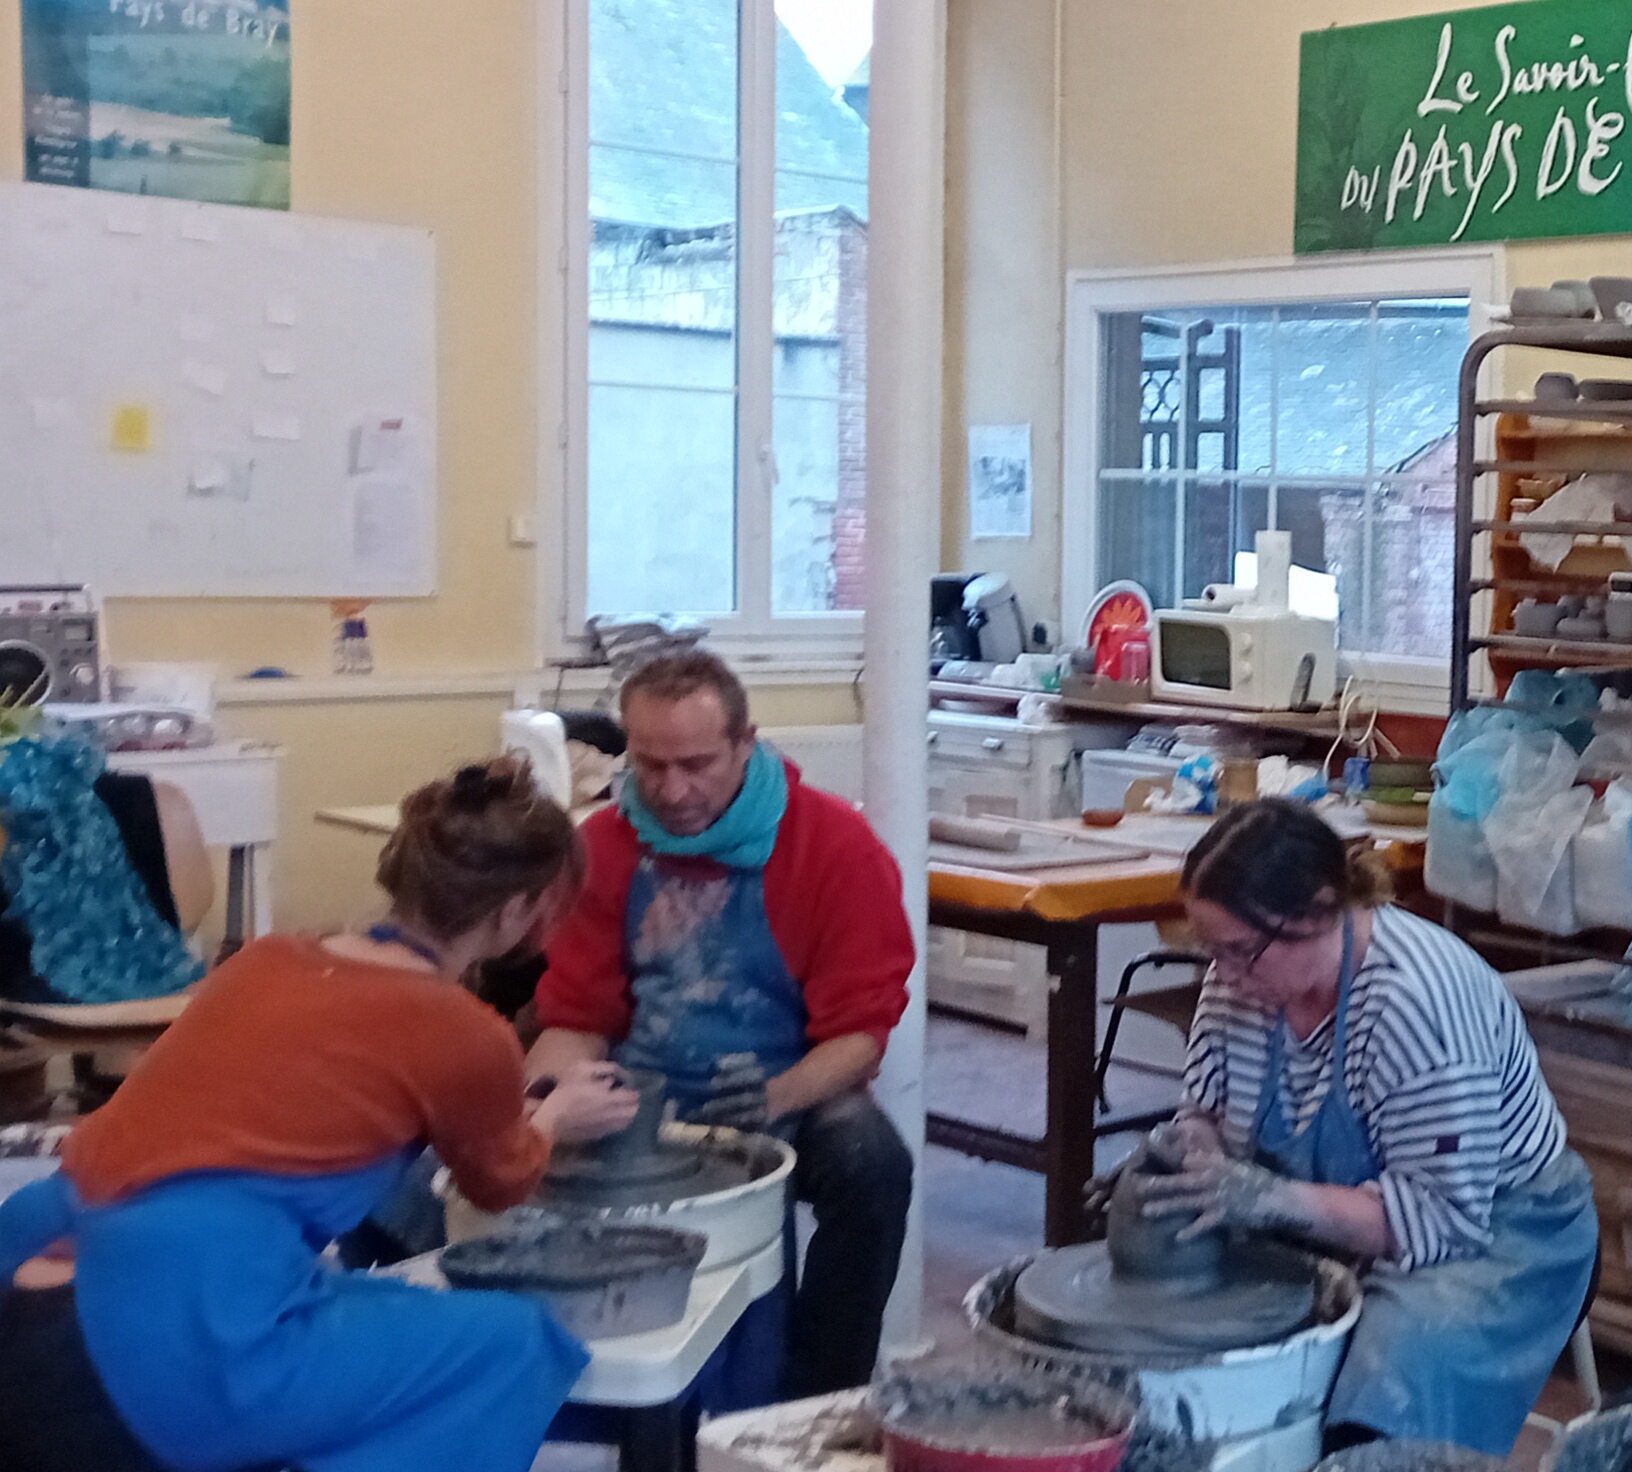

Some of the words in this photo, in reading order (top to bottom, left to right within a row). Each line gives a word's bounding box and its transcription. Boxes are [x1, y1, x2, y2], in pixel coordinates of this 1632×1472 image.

[181, 0, 209, 30] de
[226, 8, 280, 48] Bray
[1417, 22, 1480, 117] Le
[1340, 165, 1381, 214] DU
[1384, 119, 1522, 243] PAYS
[1536, 97, 1624, 201] DE
